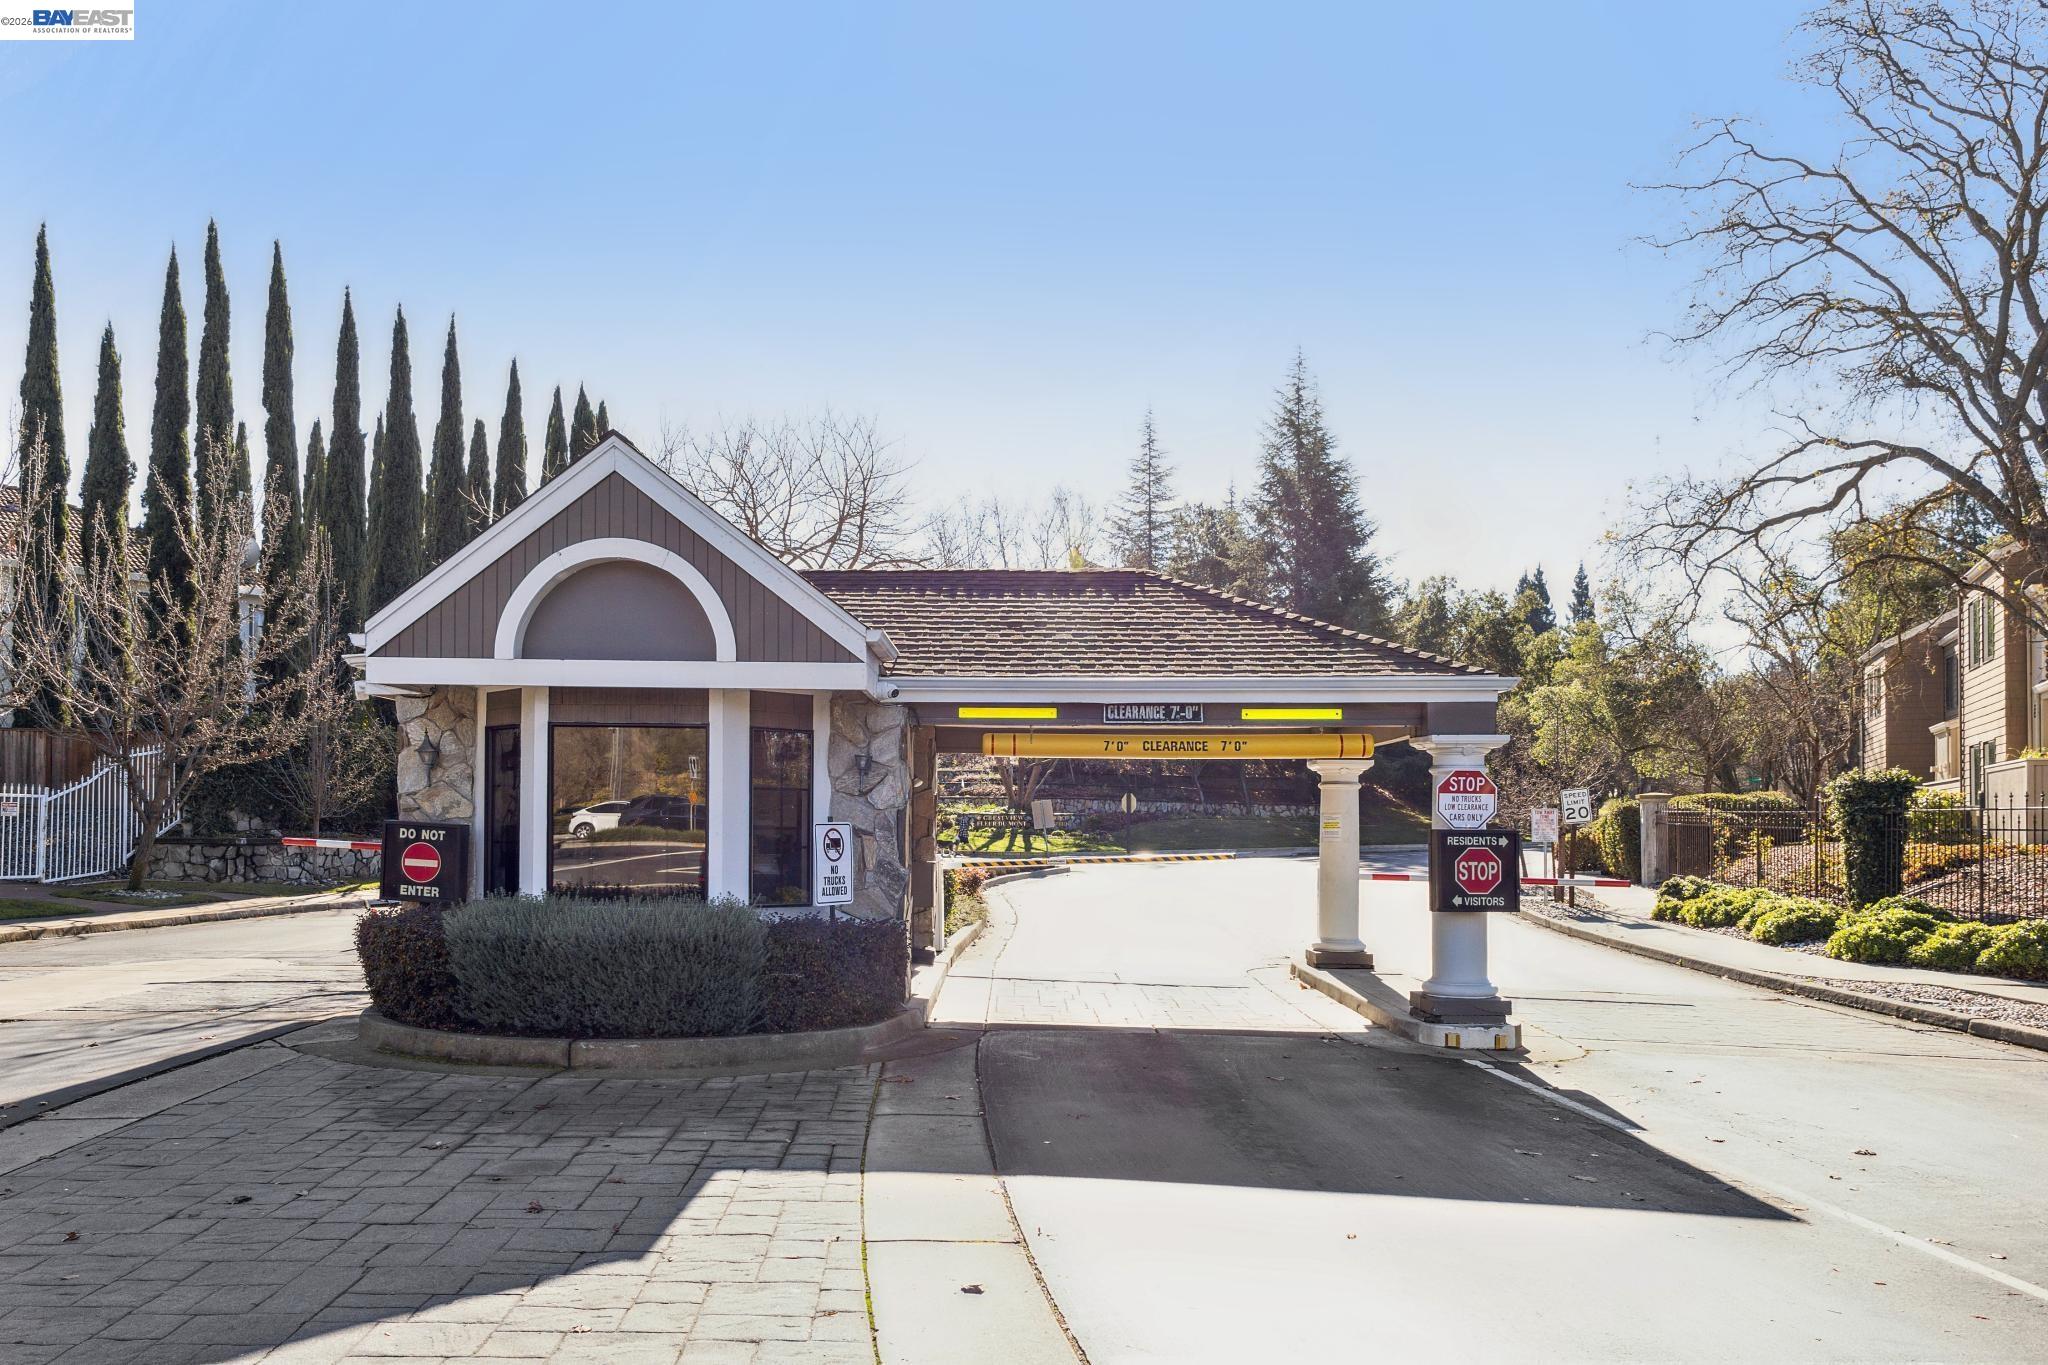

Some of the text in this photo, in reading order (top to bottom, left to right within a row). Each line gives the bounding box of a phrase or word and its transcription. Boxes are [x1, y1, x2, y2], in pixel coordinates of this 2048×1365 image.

[1108, 705, 1165, 719] CLEARANCE
[1143, 741, 1208, 751] CLEARANCE
[1449, 777, 1486, 791] STOP
[1450, 814, 1484, 822] CARS ONLY
[1566, 807, 1589, 820] 20
[400, 828, 446, 840] DO NOT
[1447, 837, 1497, 846] RESIDENTS
[831, 865, 838, 875] NO
[1459, 862, 1498, 880] STOP
[824, 876, 846, 886] TRUCKS
[400, 885, 440, 897] ENTER
[822, 886, 848, 897] ALLOWED
[1464, 896, 1505, 906] VISITORS
